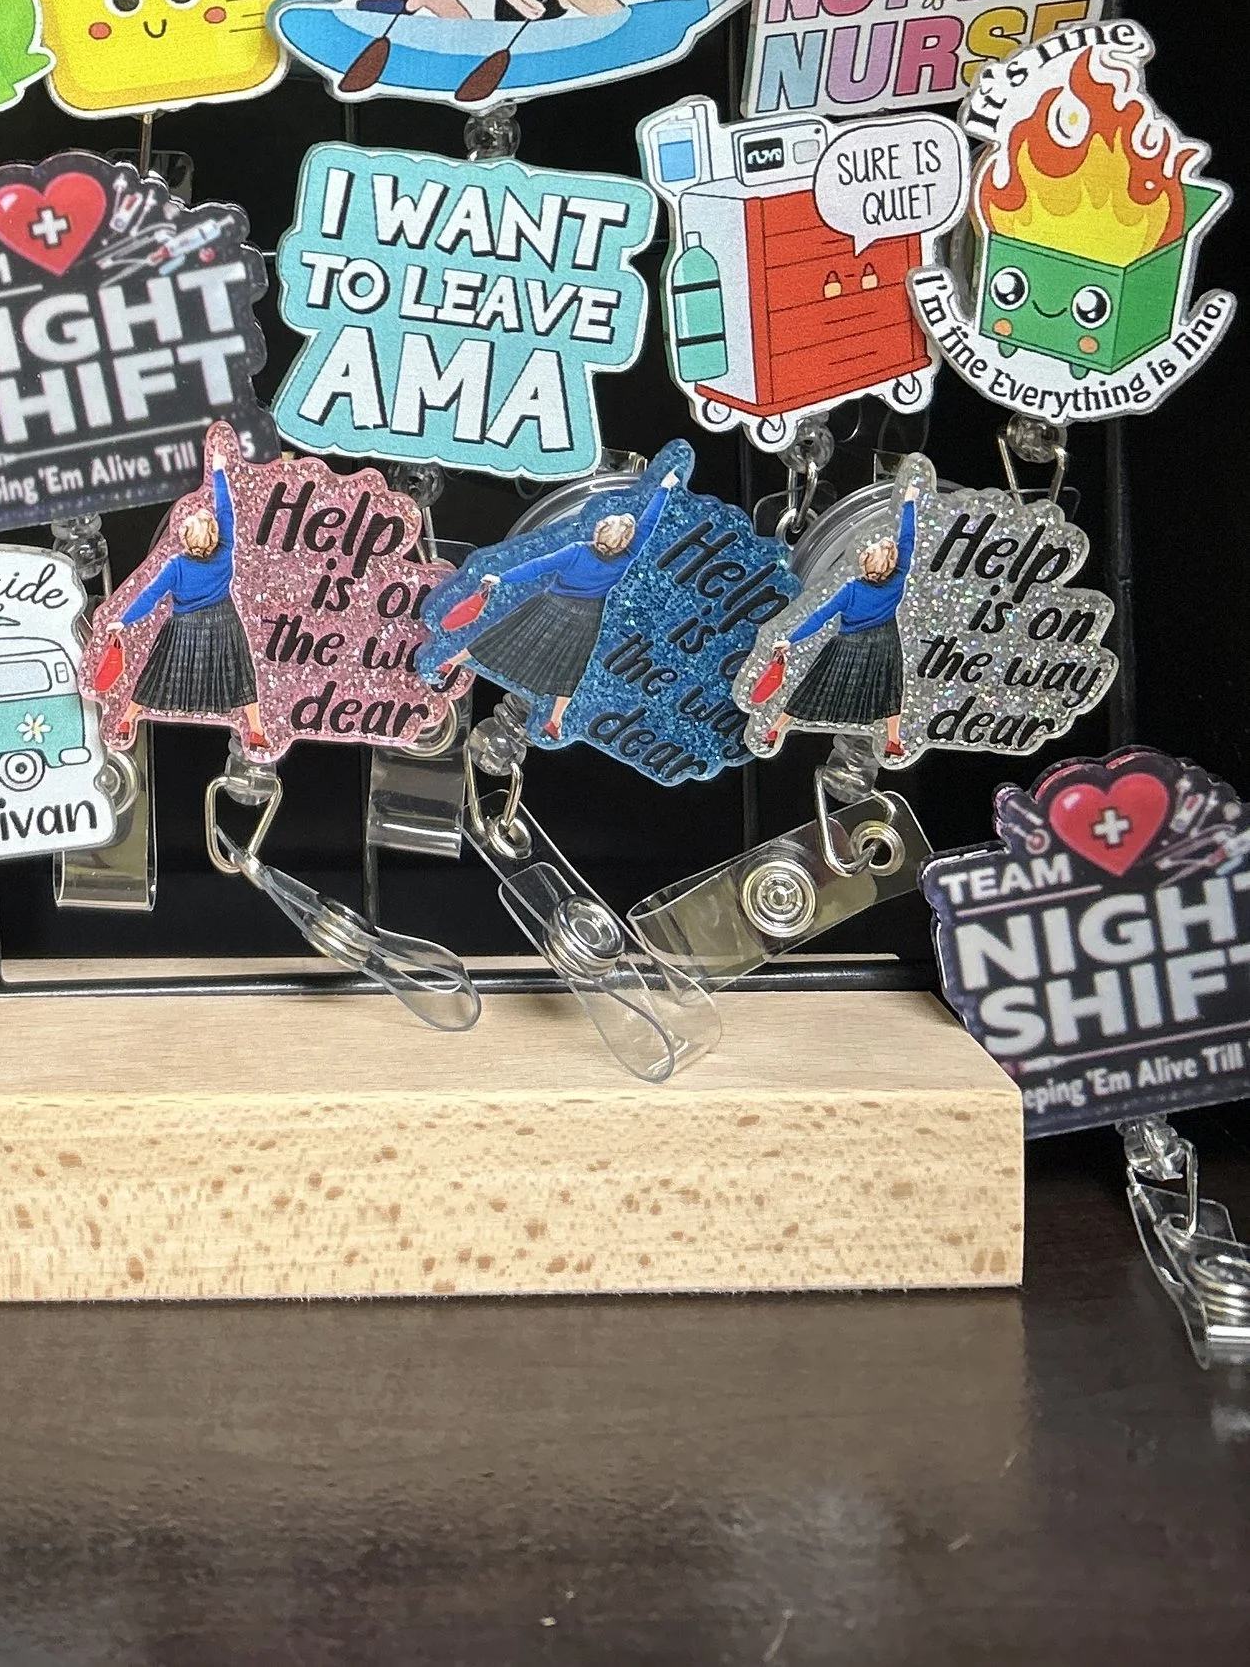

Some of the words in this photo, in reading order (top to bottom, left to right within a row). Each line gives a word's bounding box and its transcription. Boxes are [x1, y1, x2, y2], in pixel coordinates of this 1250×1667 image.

[837, 142, 902, 187] SURE
[909, 139, 943, 174] IS
[321, 167, 354, 238] I
[372, 173, 629, 273] WANT
[862, 184, 932, 222] QUIET
[301, 250, 390, 314] TO
[399, 265, 620, 343] LEAVE
[298, 325, 574, 453] AMA
[990, 368, 1150, 418] Everything
[1148, 358, 1177, 385] is
[38, 467, 83, 495] 'Em
[91, 455, 150, 484] Alive
[154, 441, 197, 472] Till
[256, 481, 405, 578] Help
[929, 513, 1072, 604] Help
[311, 558, 355, 611] is
[657, 520, 789, 632] Help
[261, 614, 345, 666] the
[667, 605, 716, 653] is
[969, 585, 1013, 633] is
[1029, 606, 1097, 644] on
[603, 630, 678, 696] the
[917, 638, 992, 684] the
[1004, 656, 1102, 708] way
[291, 681, 429, 735] dear
[927, 697, 1056, 745] dear
[588, 706, 707, 779] dear
[939, 853, 1072, 905] TEAM
[955, 871, 1250, 992] NIGH
[979, 942, 1250, 1056] SHIF
[1023, 1078, 1087, 1114] eping
[1085, 1068, 1132, 1096] 'Em
[1138, 1055, 1198, 1088] Alive
[1201, 1042, 1244, 1074] Till
